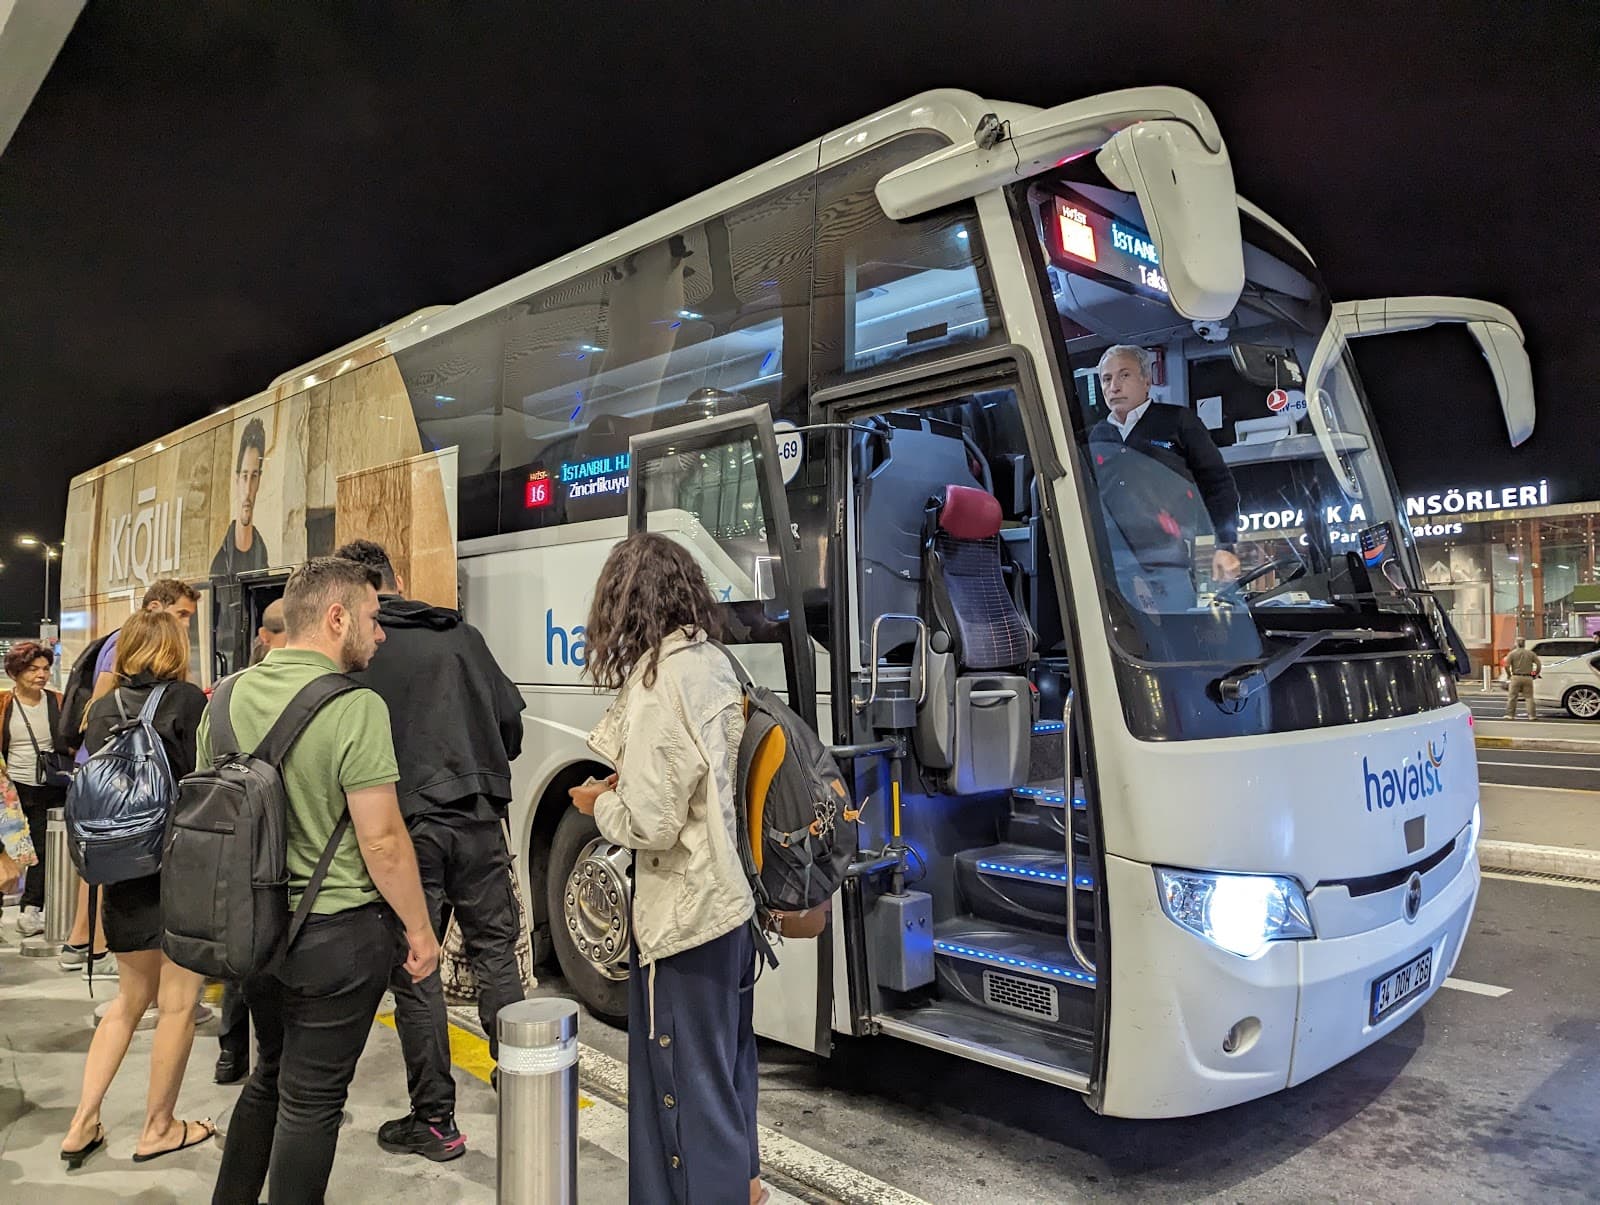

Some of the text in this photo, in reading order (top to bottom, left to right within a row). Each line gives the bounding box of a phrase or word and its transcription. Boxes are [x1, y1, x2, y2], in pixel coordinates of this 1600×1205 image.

[562, 458, 613, 481] İSTANBUL
[530, 485, 545, 503] 16
[1363, 740, 1446, 812] havaist
[1380, 981, 1390, 1009] 34
